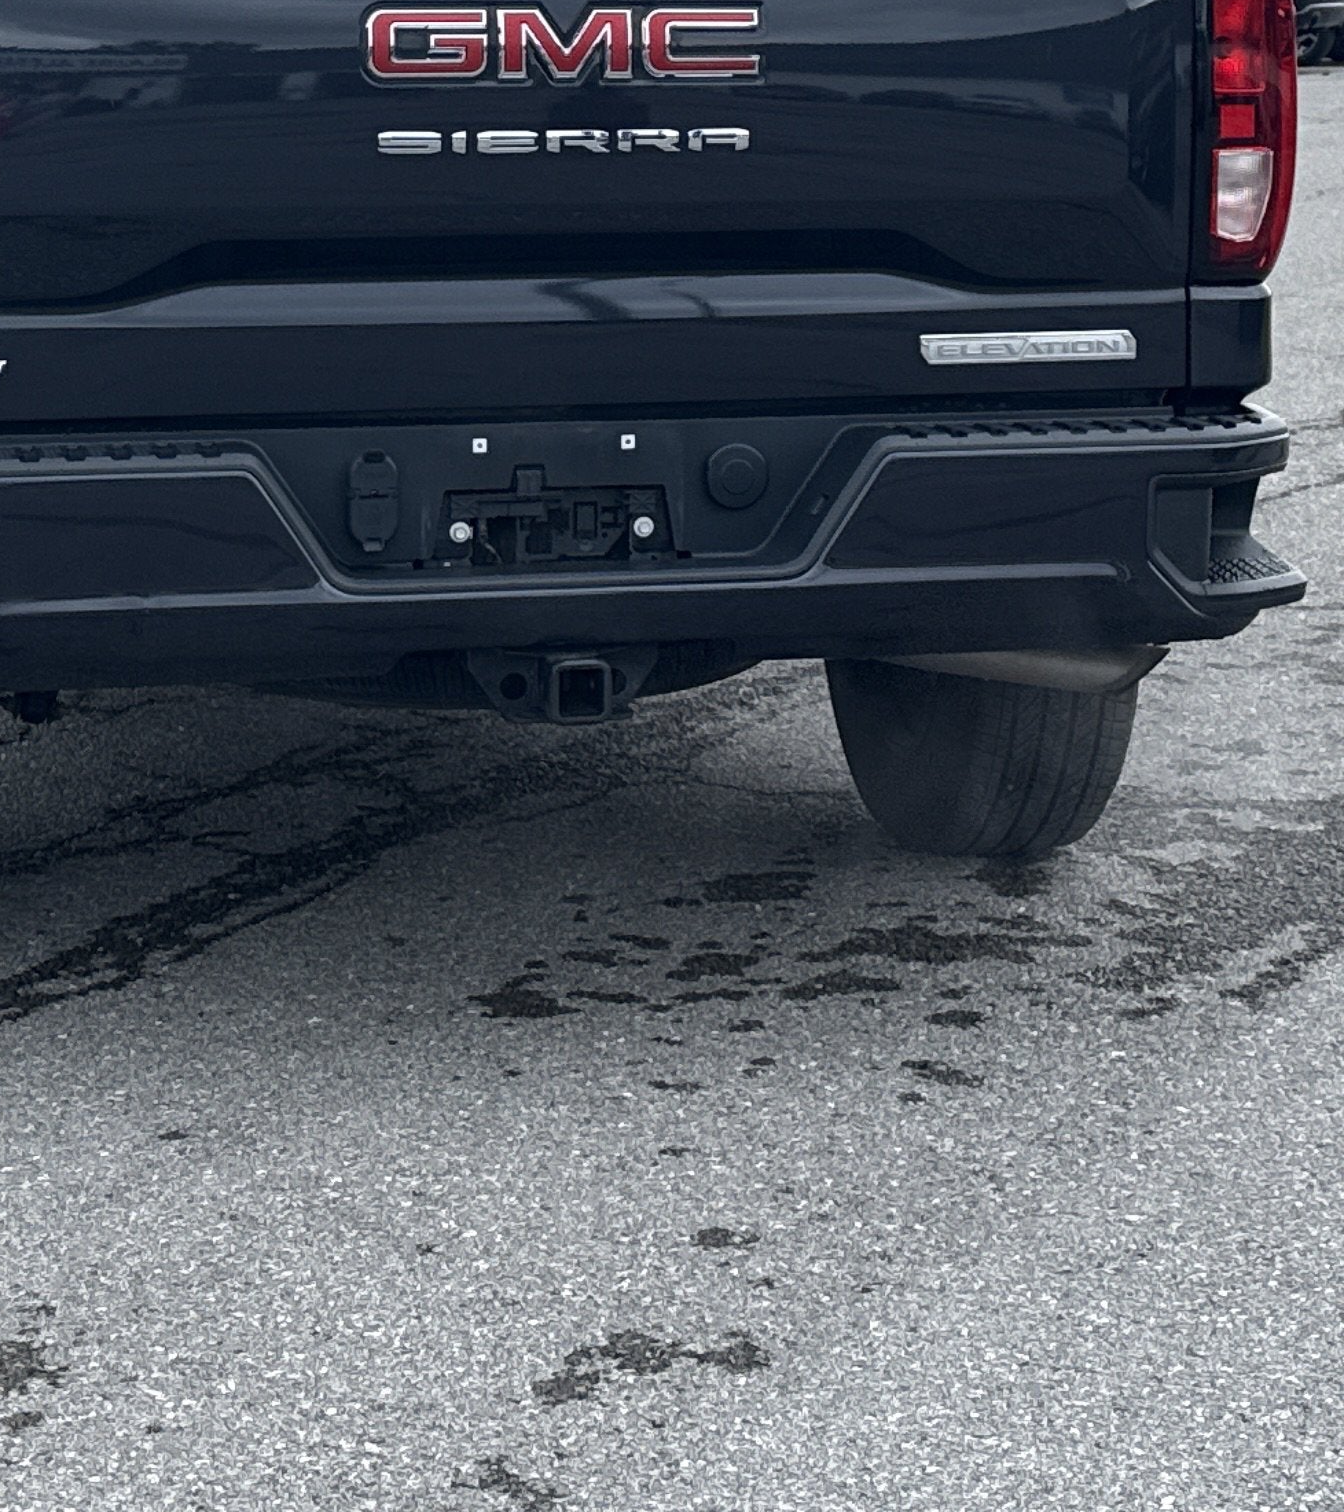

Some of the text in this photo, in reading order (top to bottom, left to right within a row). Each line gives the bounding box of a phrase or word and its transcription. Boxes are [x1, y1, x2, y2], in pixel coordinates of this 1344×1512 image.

[365, 8, 761, 80] GMC
[377, 128, 751, 155] SIERRA
[937, 339, 1121, 358] ELEVATION
